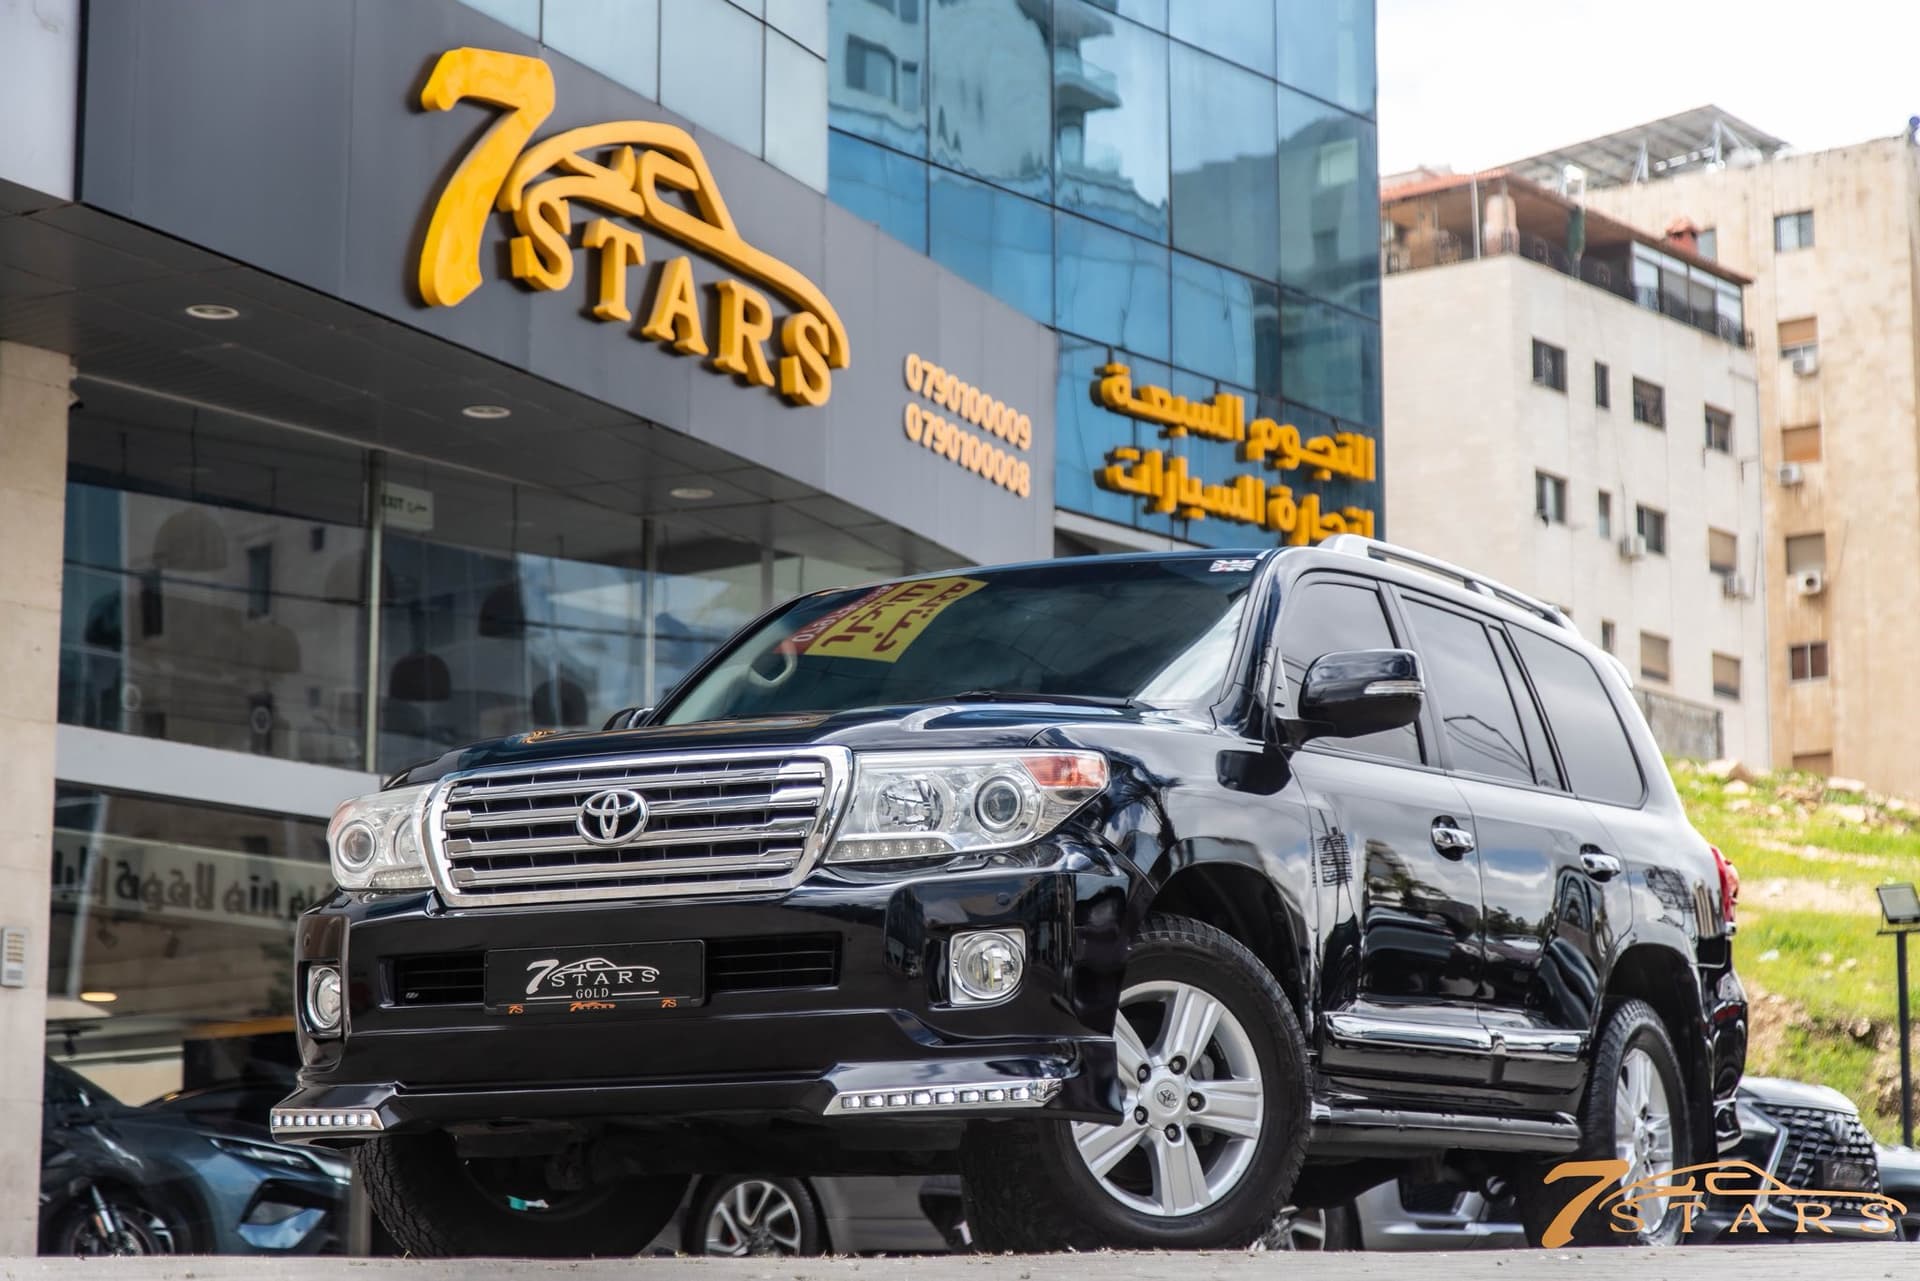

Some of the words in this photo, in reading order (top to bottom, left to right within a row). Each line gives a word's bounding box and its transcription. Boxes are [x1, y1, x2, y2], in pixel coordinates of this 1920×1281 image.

[419, 46, 556, 307] 7
[510, 188, 832, 407] STARS
[905, 353, 1032, 451] 0790100009
[1100, 361, 1246, 442] السبعة
[905, 402, 1031, 498] 0790100008
[1104, 447, 1266, 524] السيارات
[1246, 417, 1377, 482] النجوم
[526, 959, 560, 995] 7
[551, 969, 657, 988] STARS
[575, 987, 609, 999] GOLD
